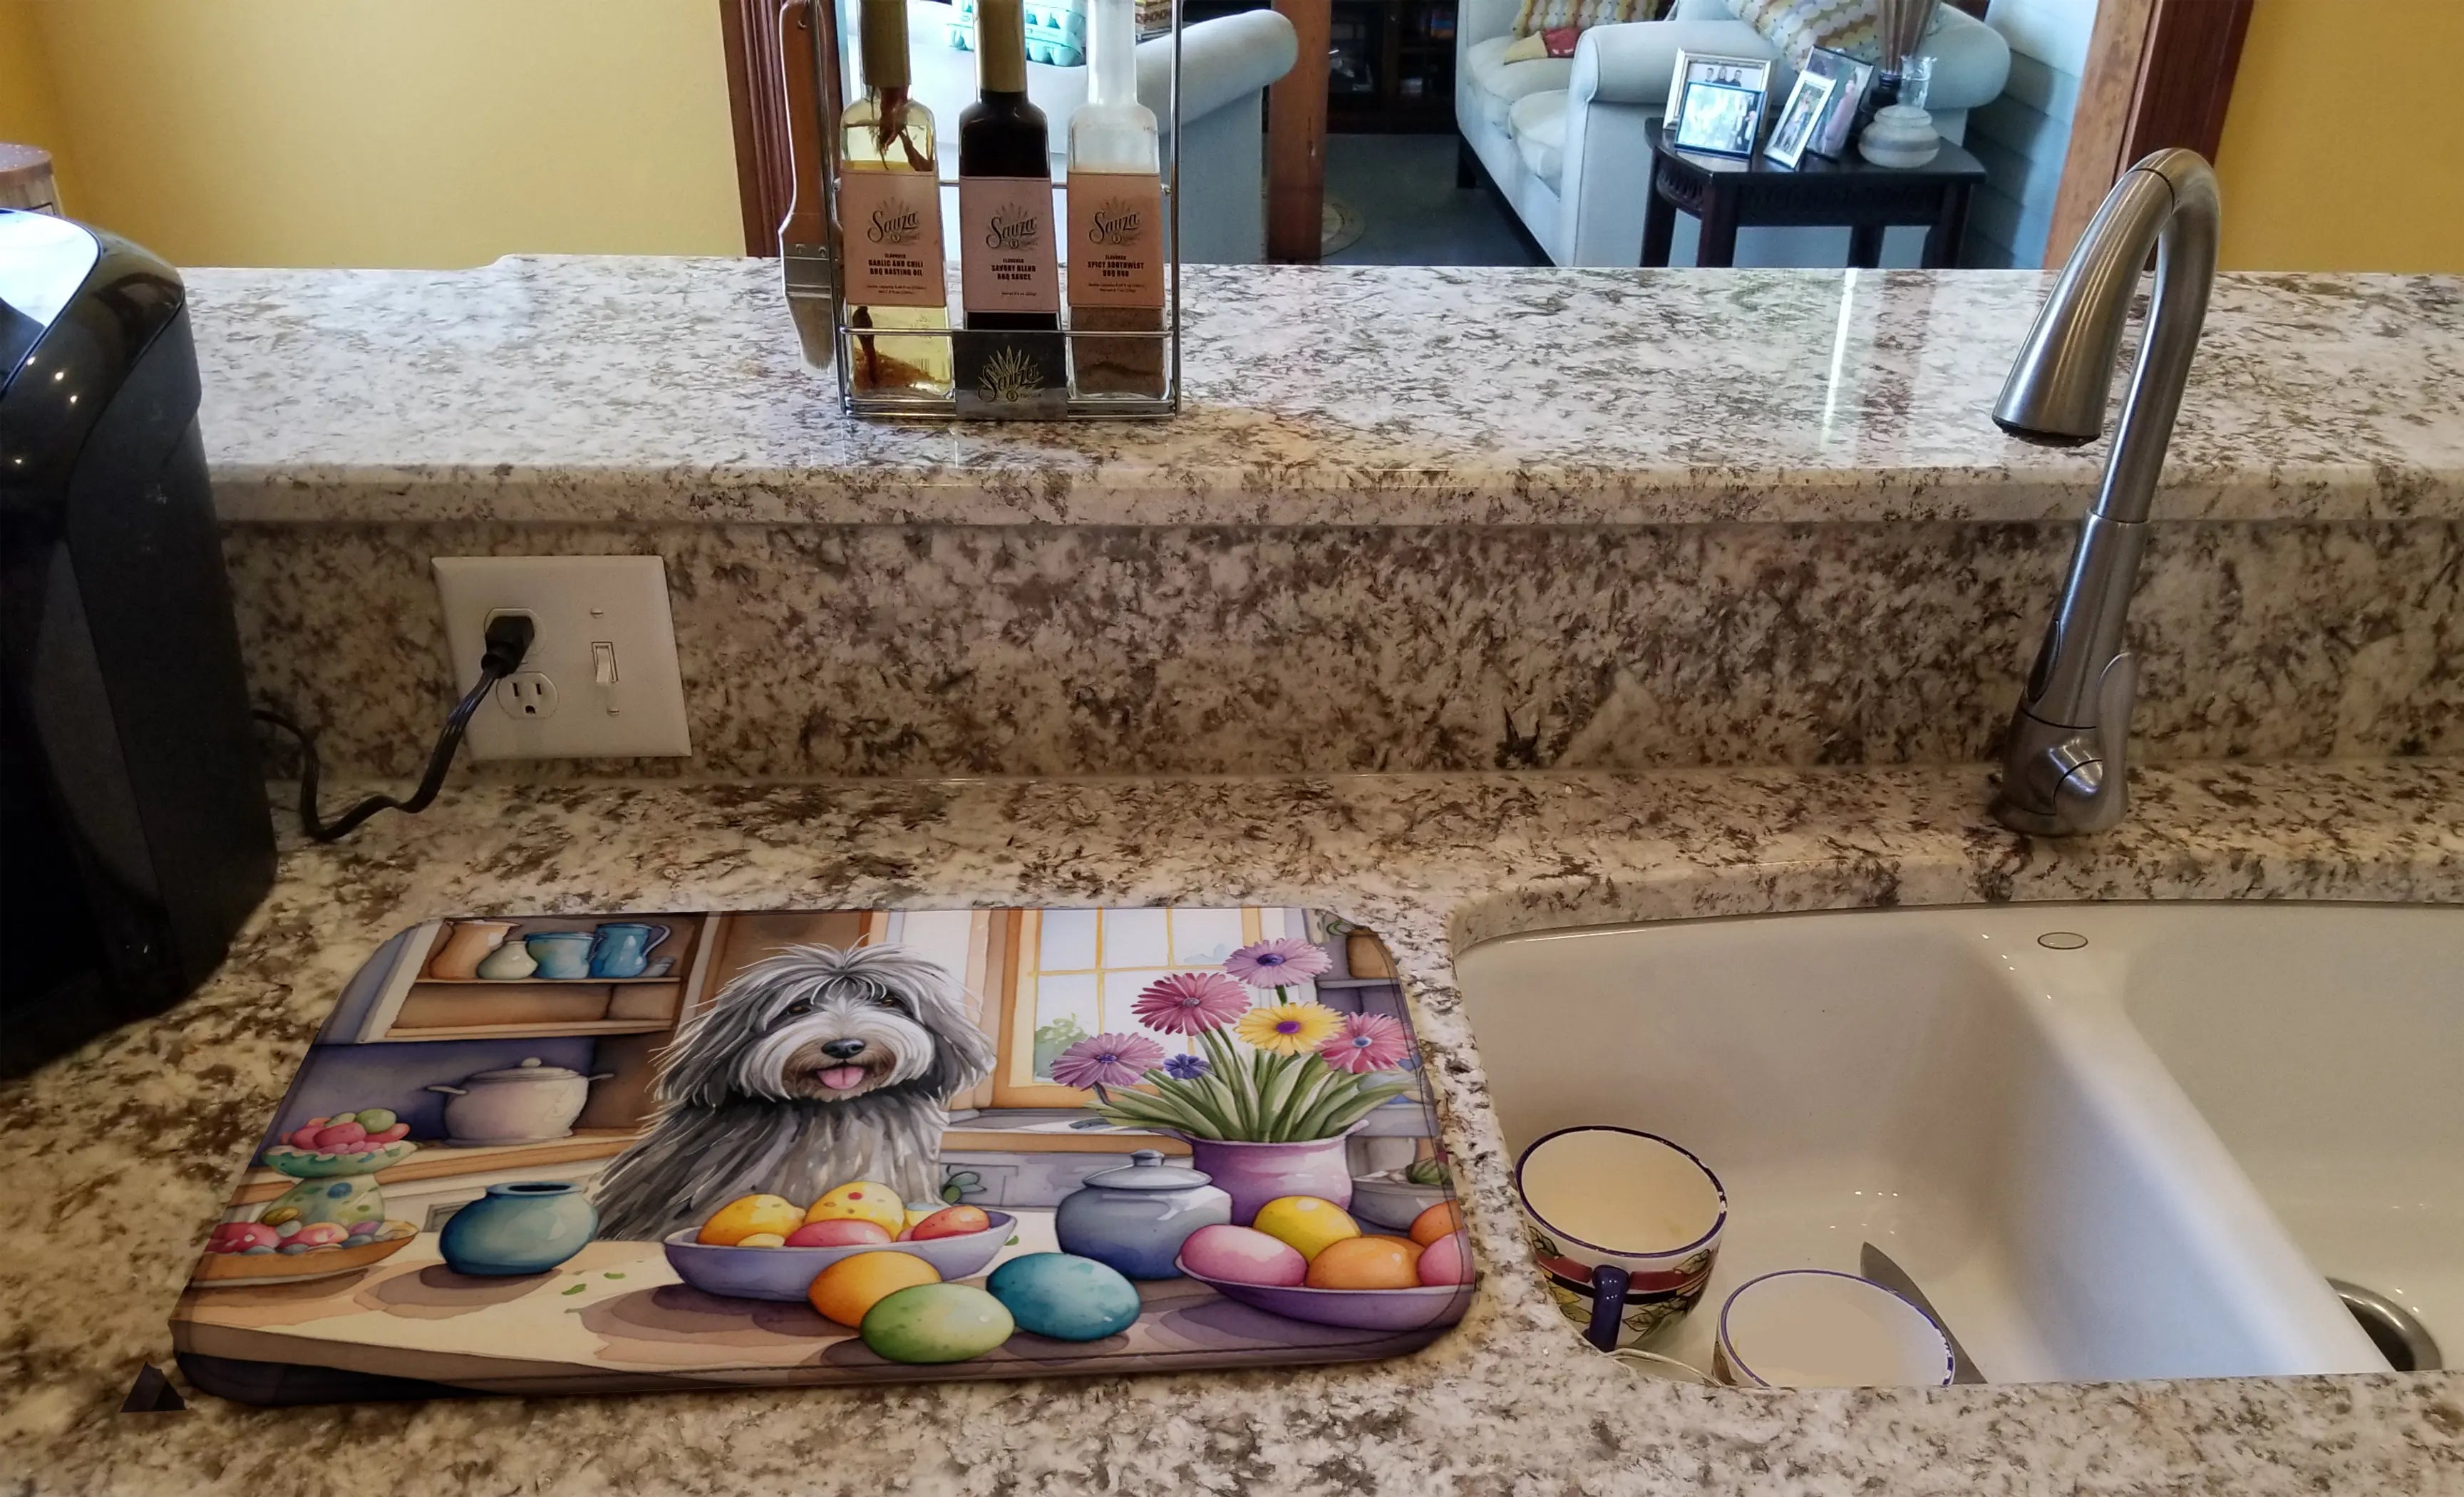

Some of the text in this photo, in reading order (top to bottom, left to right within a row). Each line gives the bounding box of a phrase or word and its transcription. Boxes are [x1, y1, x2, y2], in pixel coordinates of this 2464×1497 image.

[867, 210, 919, 242] Sauza
[986, 216, 1037, 249] Sauza
[1088, 211, 1140, 243] Sauza
[978, 364, 1043, 403] Sauza
